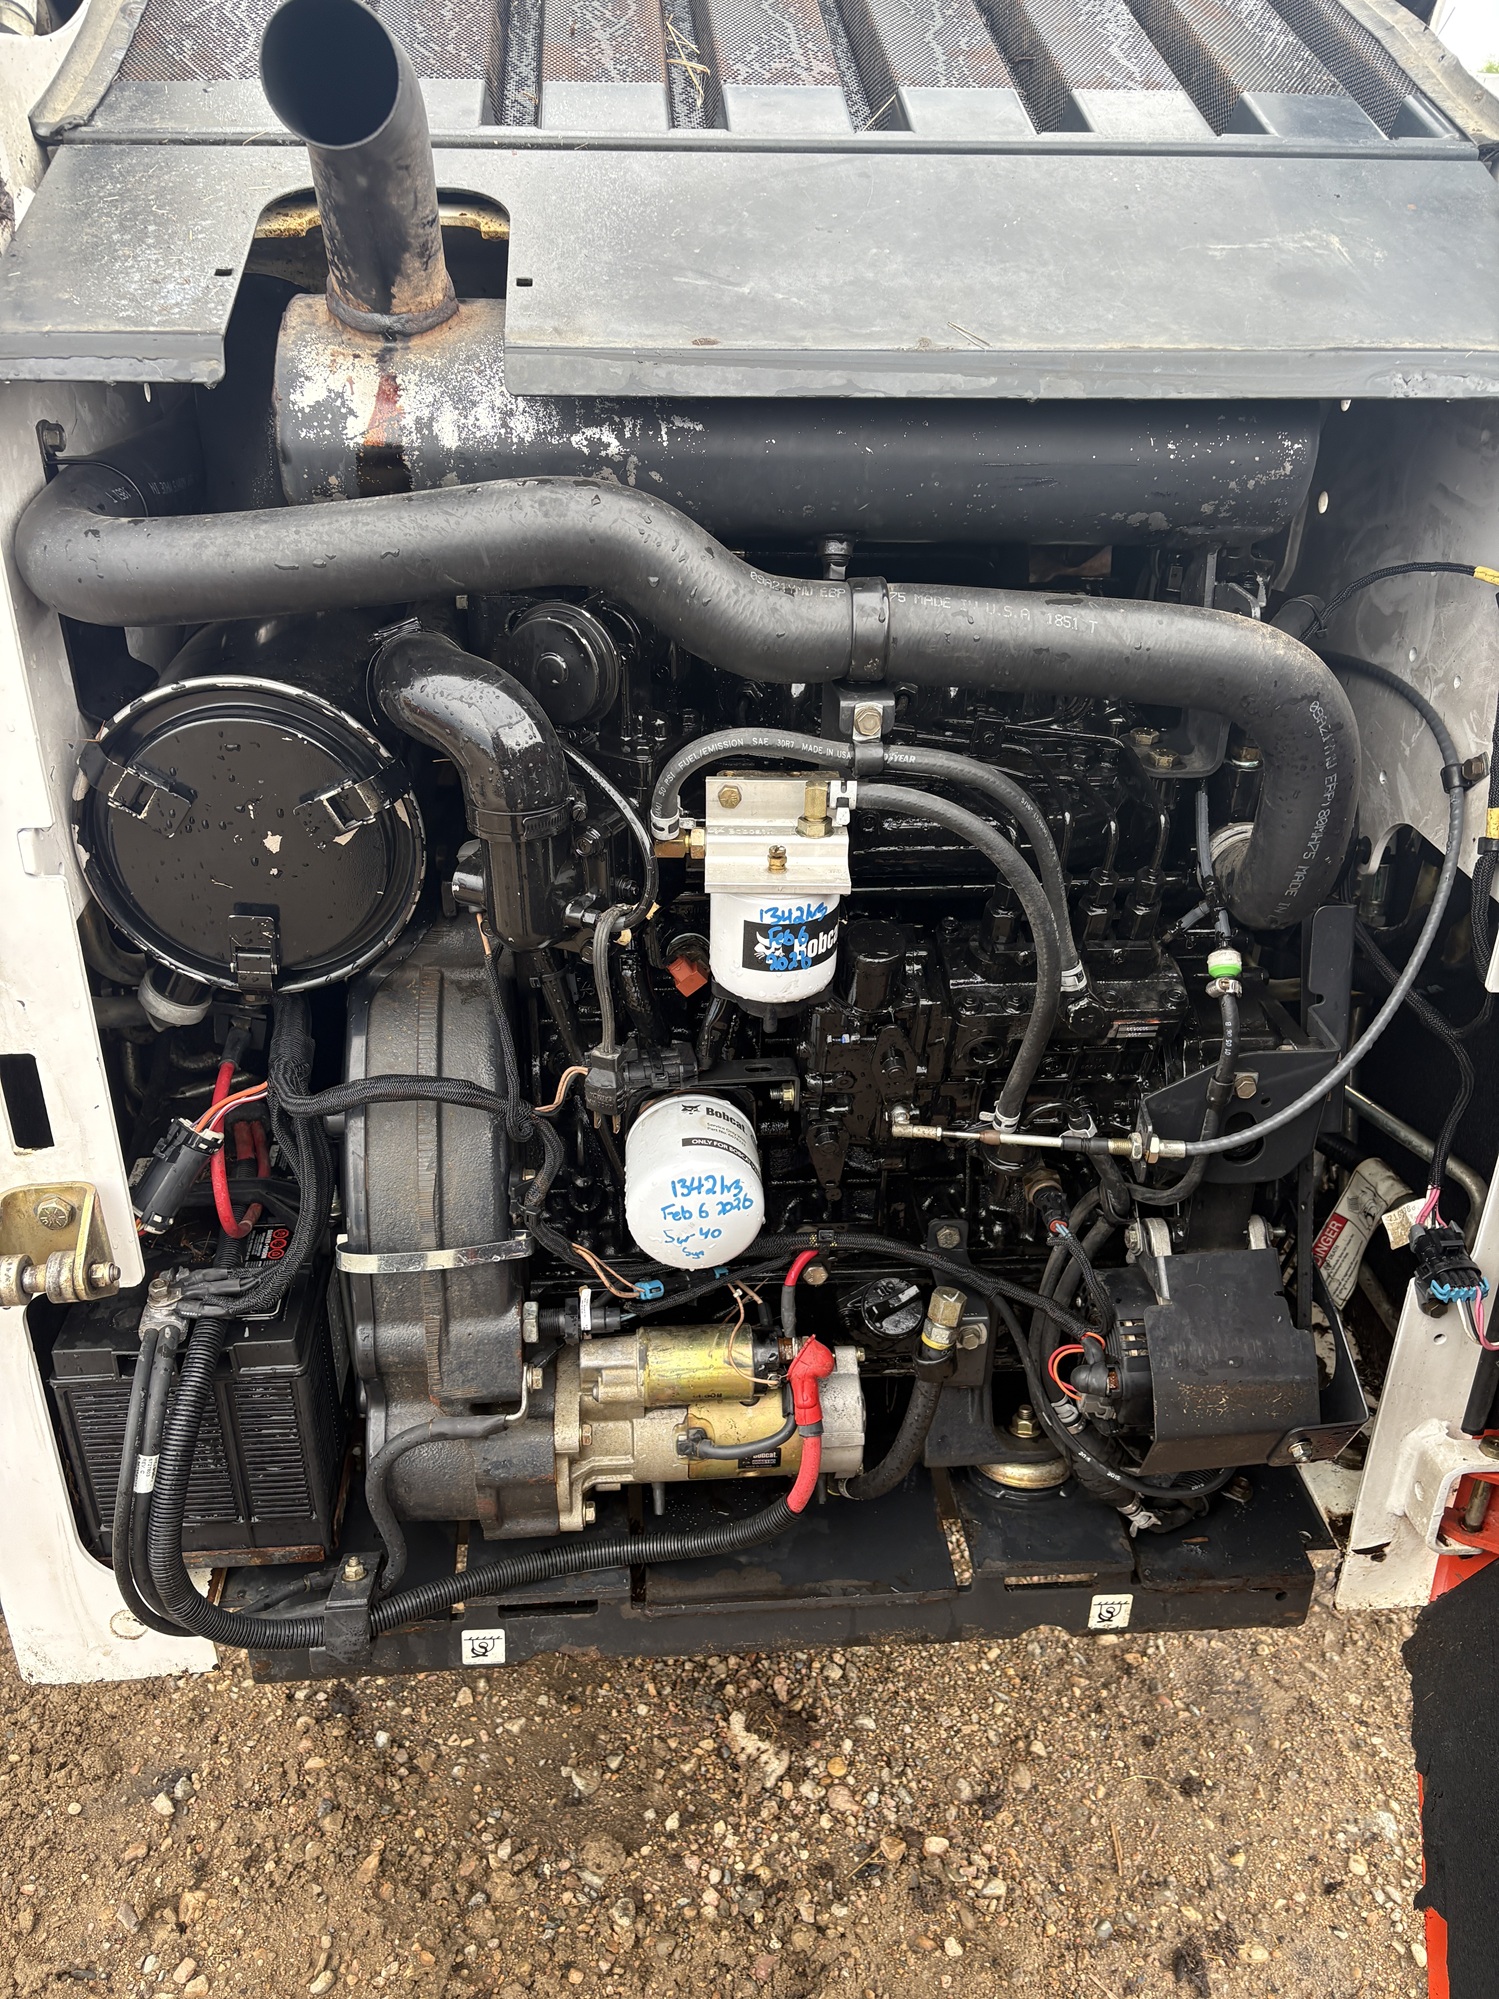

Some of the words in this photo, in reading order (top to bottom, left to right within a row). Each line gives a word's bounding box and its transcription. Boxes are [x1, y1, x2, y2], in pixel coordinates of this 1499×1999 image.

[914, 594, 951, 609] MADE
[664, 772, 676, 787] PSI
[678, 738, 744, 771] FUEL/EMISSION
[752, 737, 770, 747] SAE
[776, 738, 796, 749] 30R7
[801, 742, 824, 755] MADE
[826, 747, 834, 757] IN
[836, 750, 852, 760] USA
[1285, 865, 1310, 898] MADE
[768, 926, 796, 949] Feb
[797, 925, 810, 947] 6
[766, 951, 813, 972] 2026
[713, 1141, 728, 1150] FOR
[660, 1203, 693, 1221] Feb
[698, 1202, 710, 1219] 6
[715, 1192, 754, 1216] 2026
